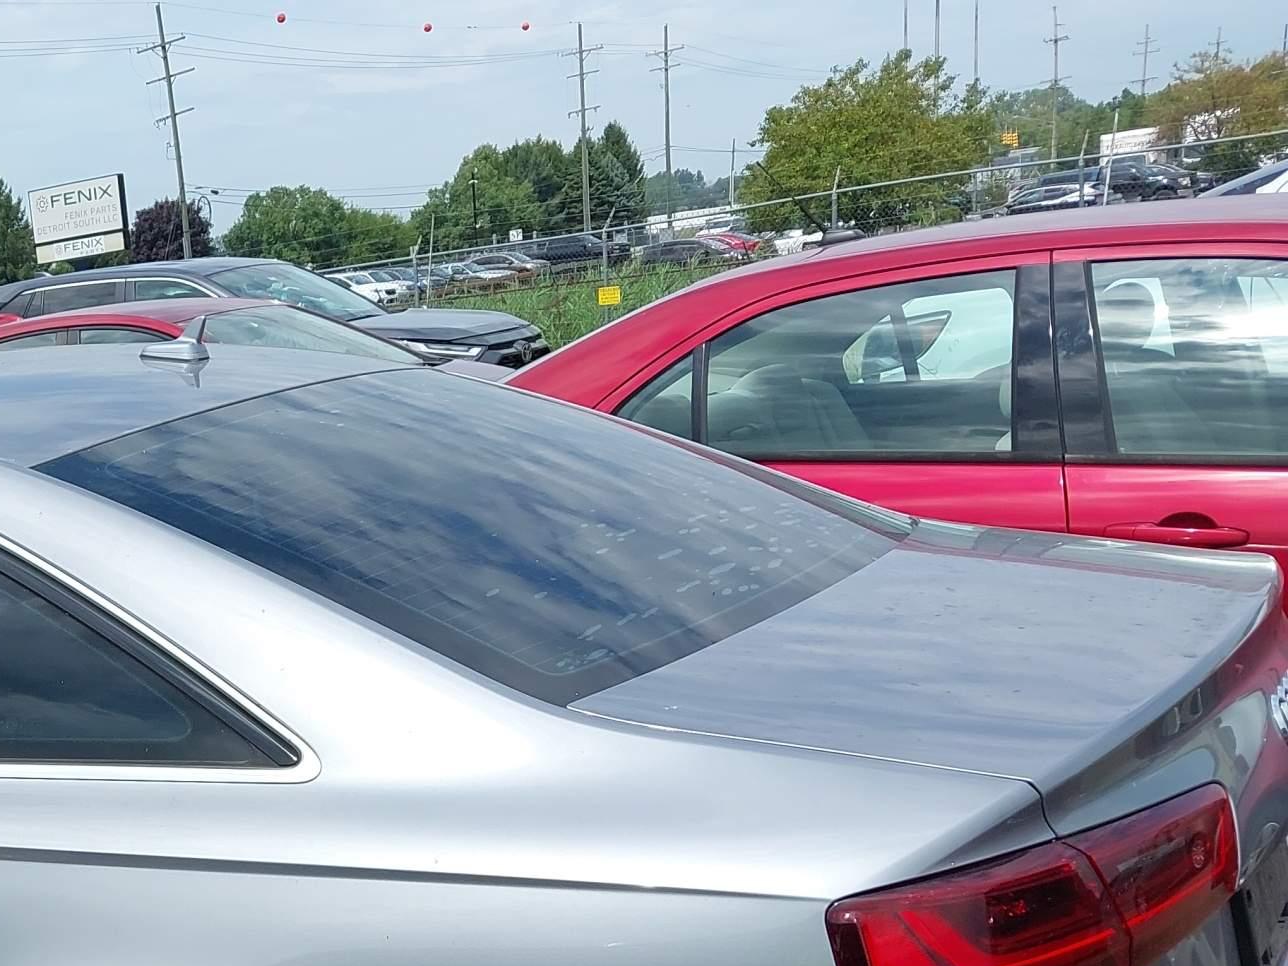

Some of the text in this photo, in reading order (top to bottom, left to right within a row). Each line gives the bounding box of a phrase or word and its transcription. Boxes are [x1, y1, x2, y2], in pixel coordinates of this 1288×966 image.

[50, 184, 112, 208] FENIX
[64, 204, 118, 220] FENIX PARTS
[37, 213, 119, 235] DETROIT SOUTH LLC
[63, 237, 103, 252] FENIX
